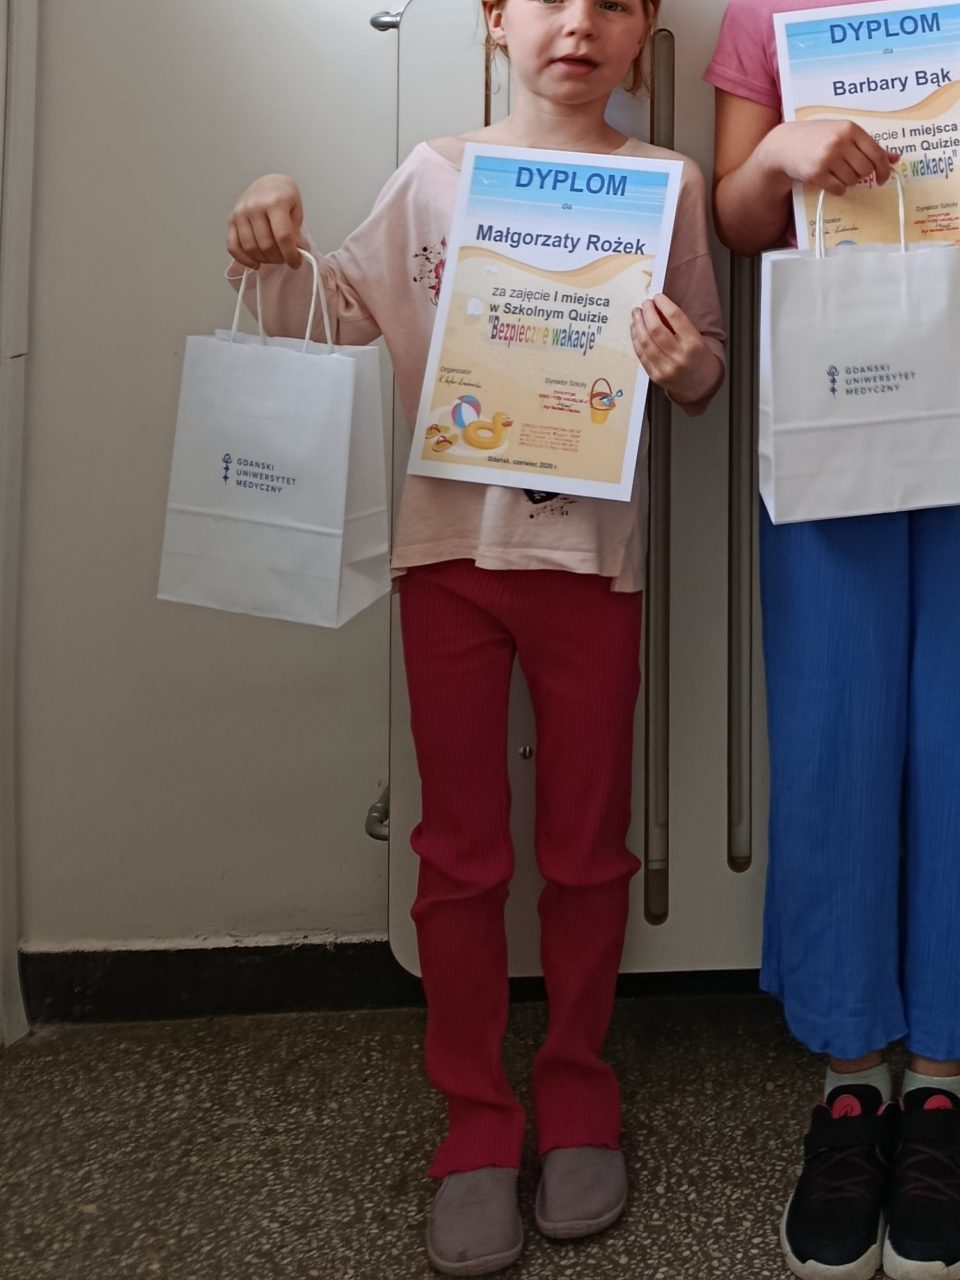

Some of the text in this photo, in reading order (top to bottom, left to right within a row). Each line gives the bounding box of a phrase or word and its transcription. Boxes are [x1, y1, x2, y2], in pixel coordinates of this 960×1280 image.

[830, 12, 941, 44] DYPLOM
[833, 68, 952, 96] Barbary Bąk
[910, 123, 958, 138] miejsca
[921, 138, 960, 151] Quizie
[910, 149, 958, 179] wakacje"
[516, 166, 628, 197] DYPLOM
[476, 224, 646, 256] Małgorzaty Rożek
[488, 316, 602, 356] "Bezpieczne wakacje"
[236, 469, 296, 485] UNIWERSYTET
[236, 480, 282, 493] MEDYCZNY
